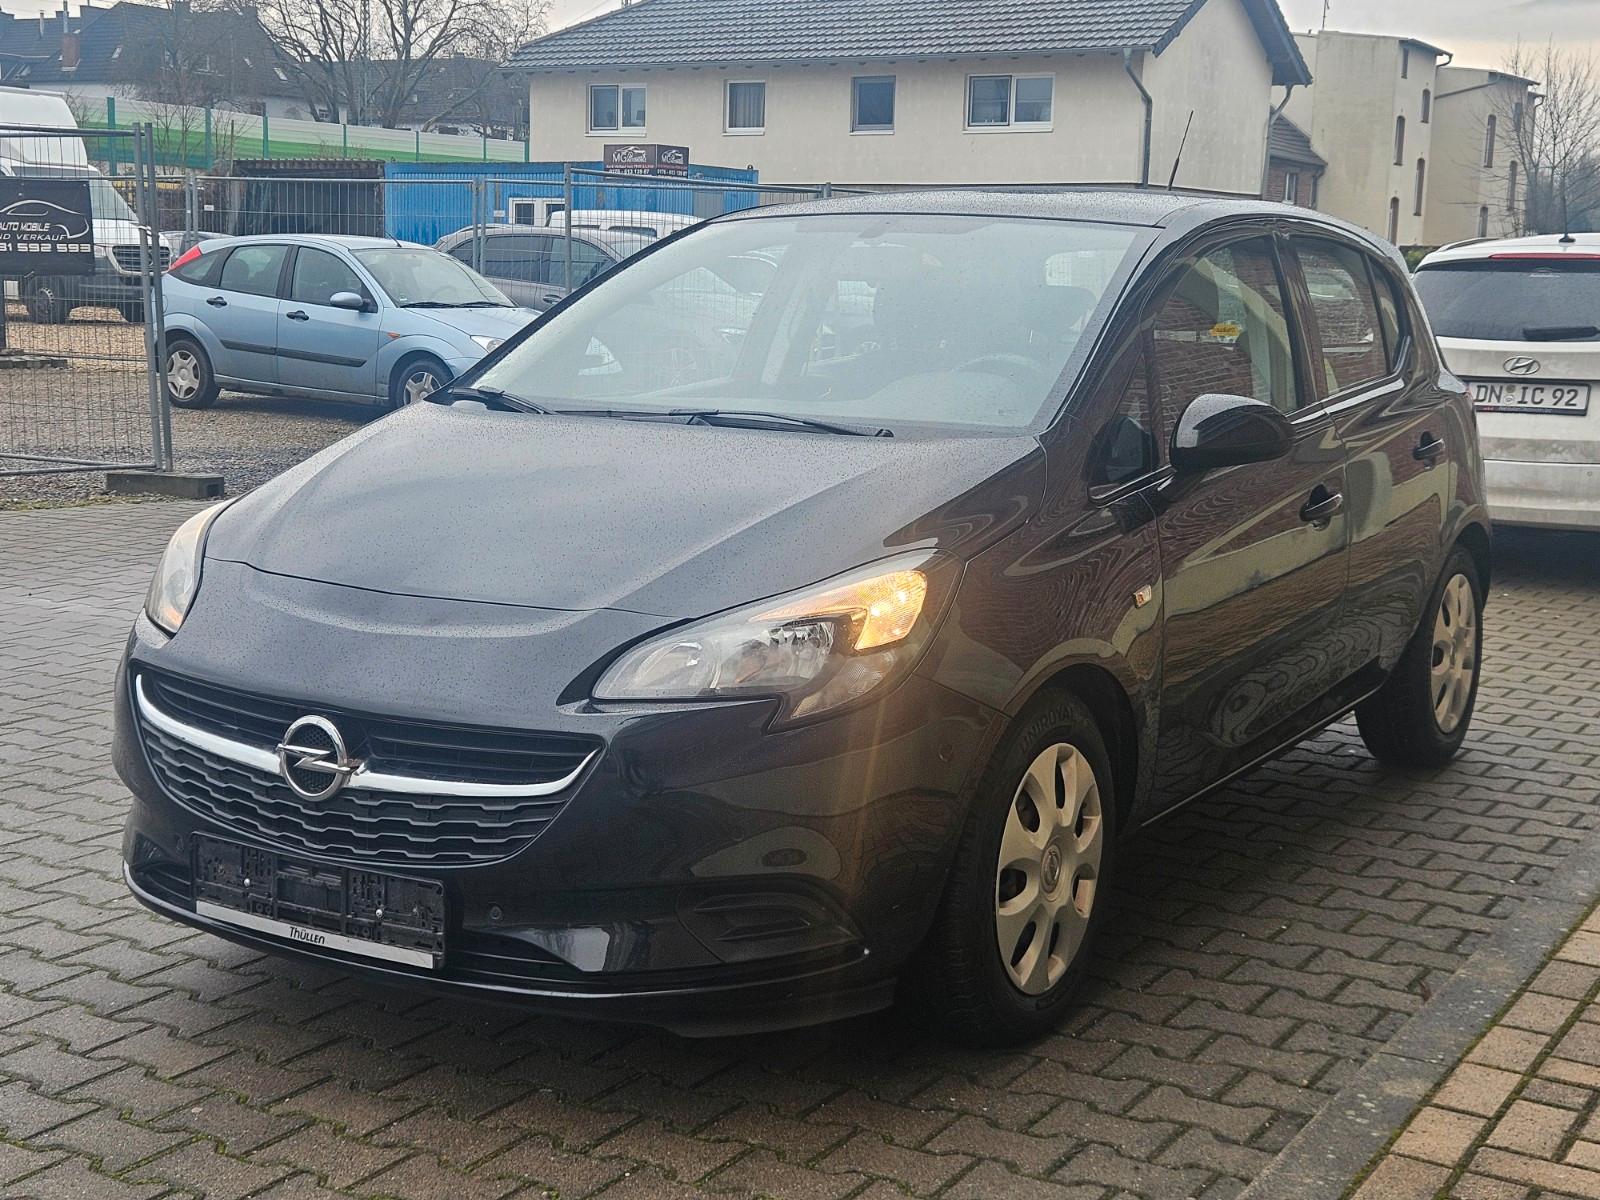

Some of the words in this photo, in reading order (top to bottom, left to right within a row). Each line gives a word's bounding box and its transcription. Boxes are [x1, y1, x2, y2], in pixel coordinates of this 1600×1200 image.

[20, 222, 51, 232] MOBILE
[16, 233, 67, 241] VERKAUF
[17, 243, 52, 252] 592
[56, 243, 92, 253] 593
[1473, 385, 1503, 403] DN
[1517, 386, 1545, 405] IC
[1551, 388, 1579, 407] 92
